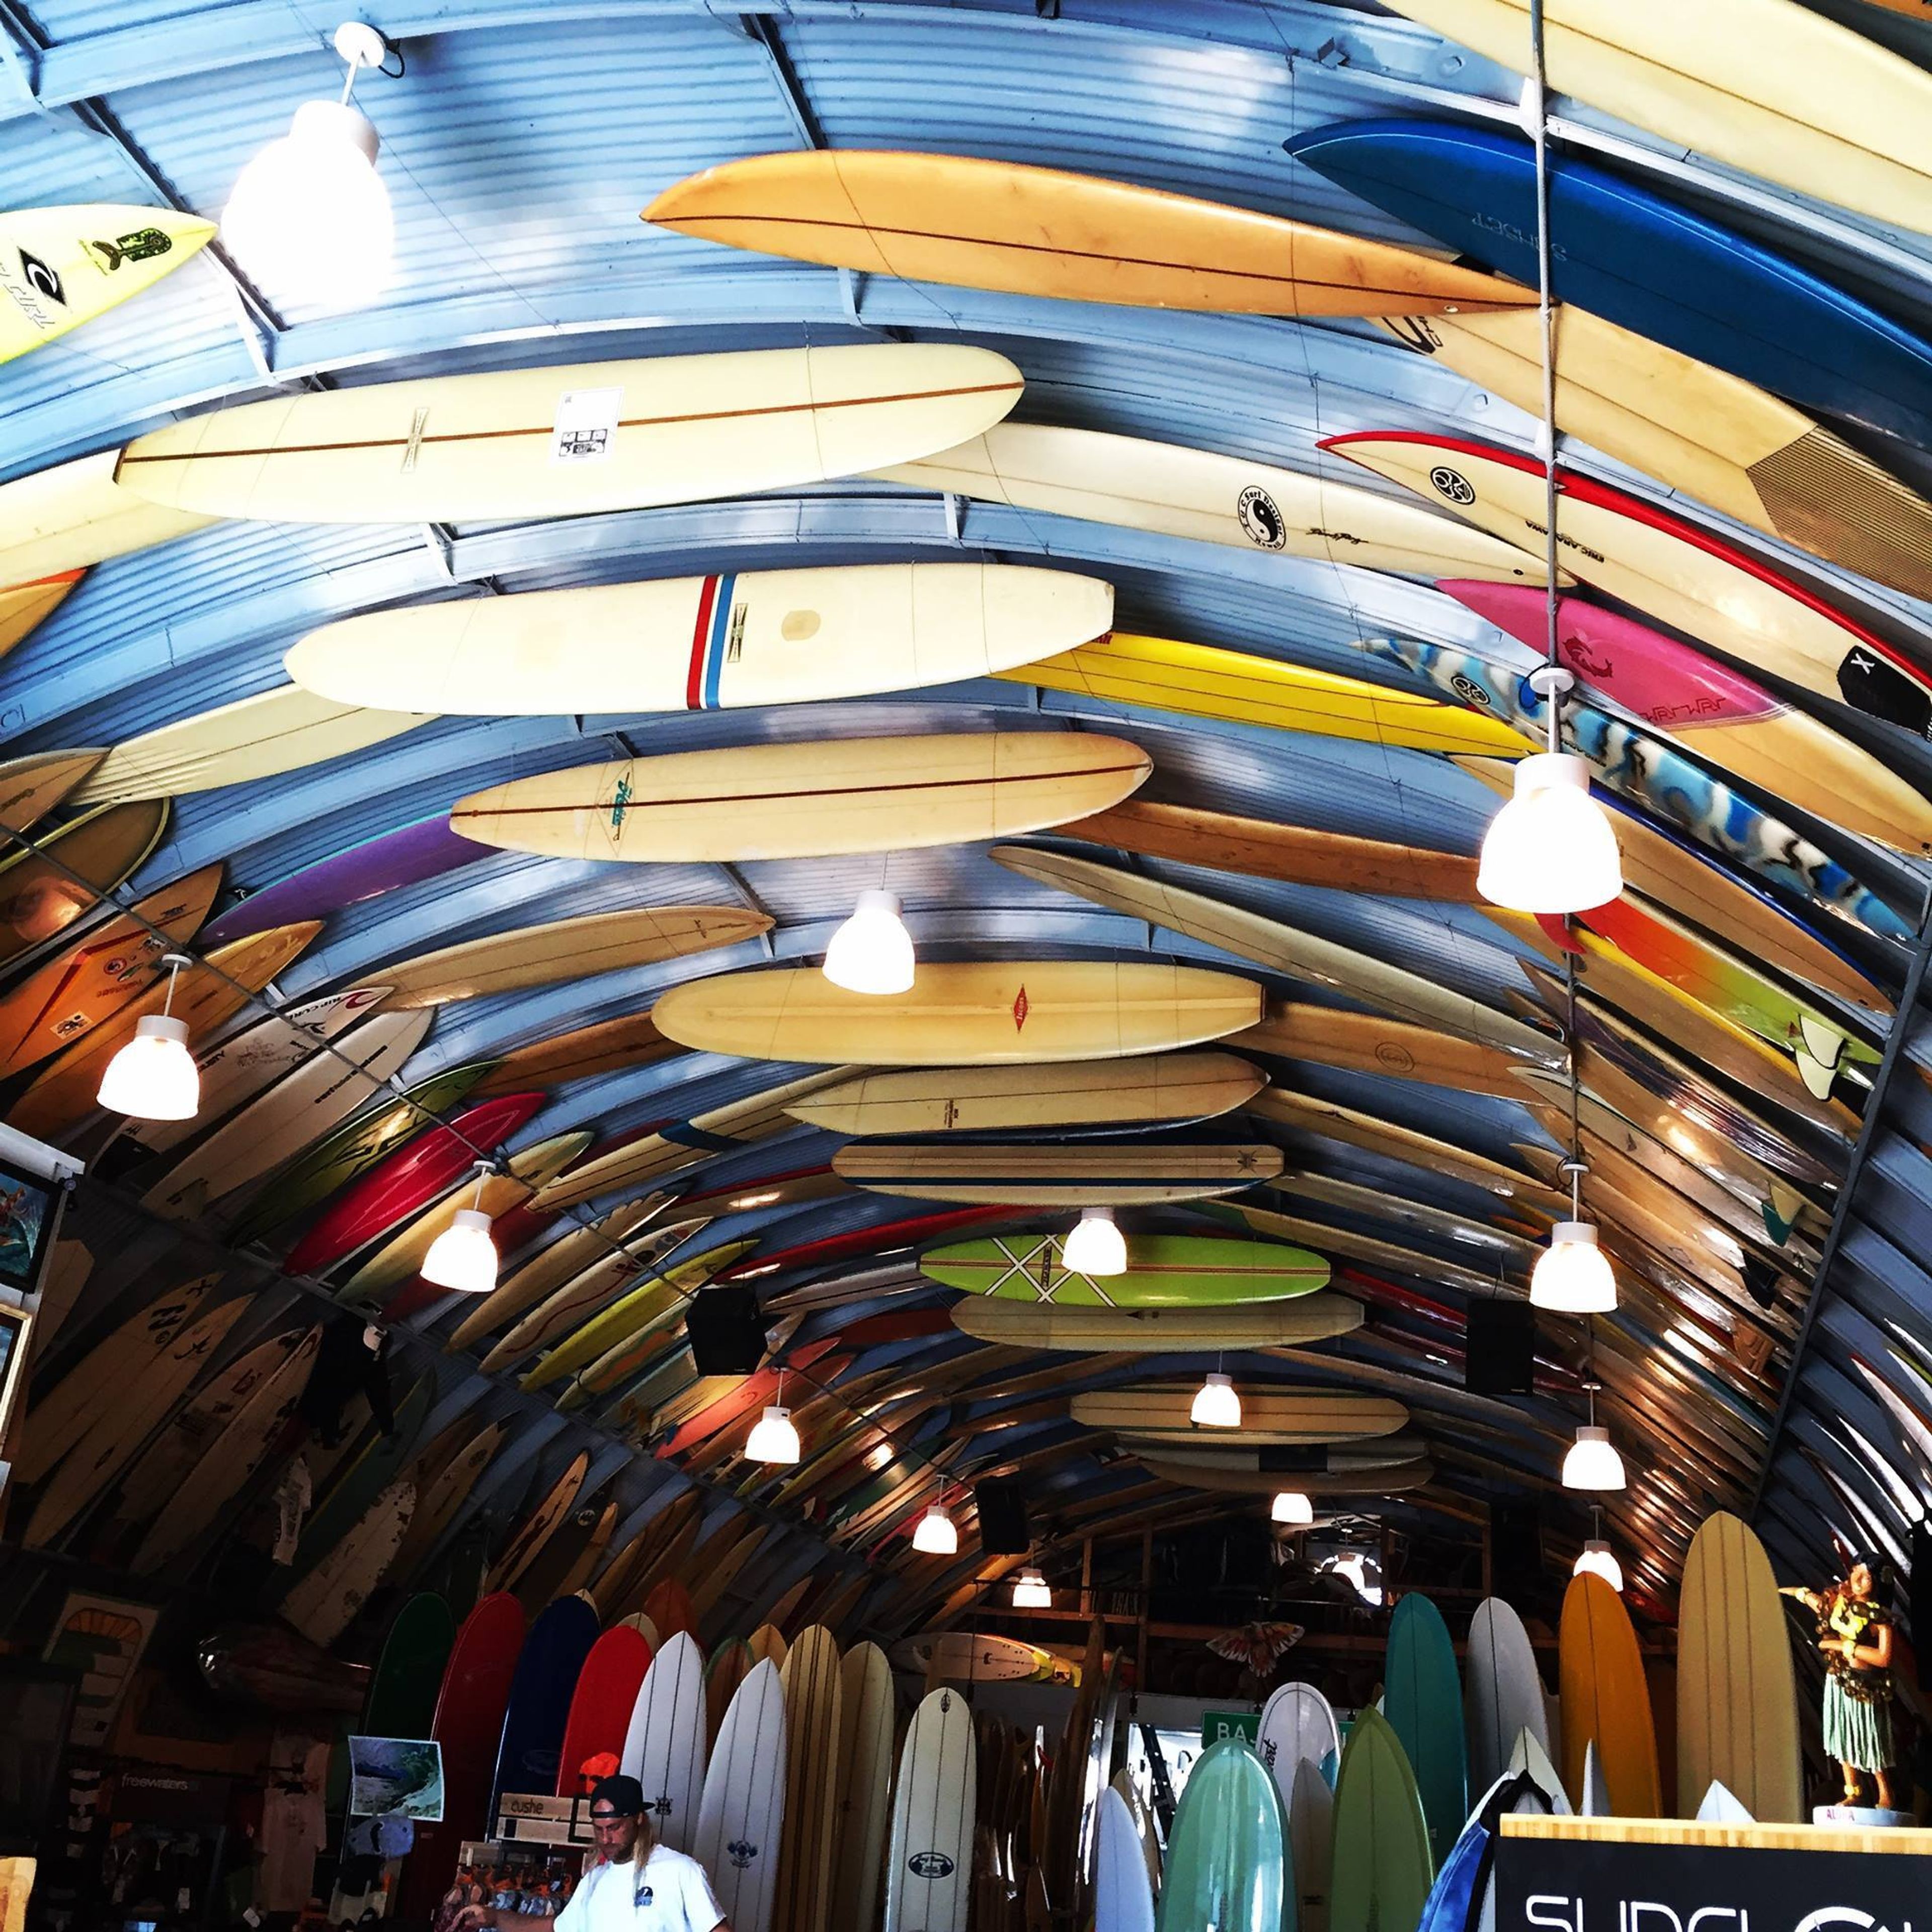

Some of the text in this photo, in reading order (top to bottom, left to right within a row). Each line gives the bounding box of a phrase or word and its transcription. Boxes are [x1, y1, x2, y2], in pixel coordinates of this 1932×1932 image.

[1472, 212, 1567, 262] SNSET
[1244, 491, 1261, 501] Surf
[1525, 520, 1605, 563] ERIC ARAAWA
[320, 997, 341, 1008] RIP
[1217, 1722, 1256, 1744] BA
[121, 1773, 188, 1791] freewaters
[511, 1798, 544, 1815] cushe
